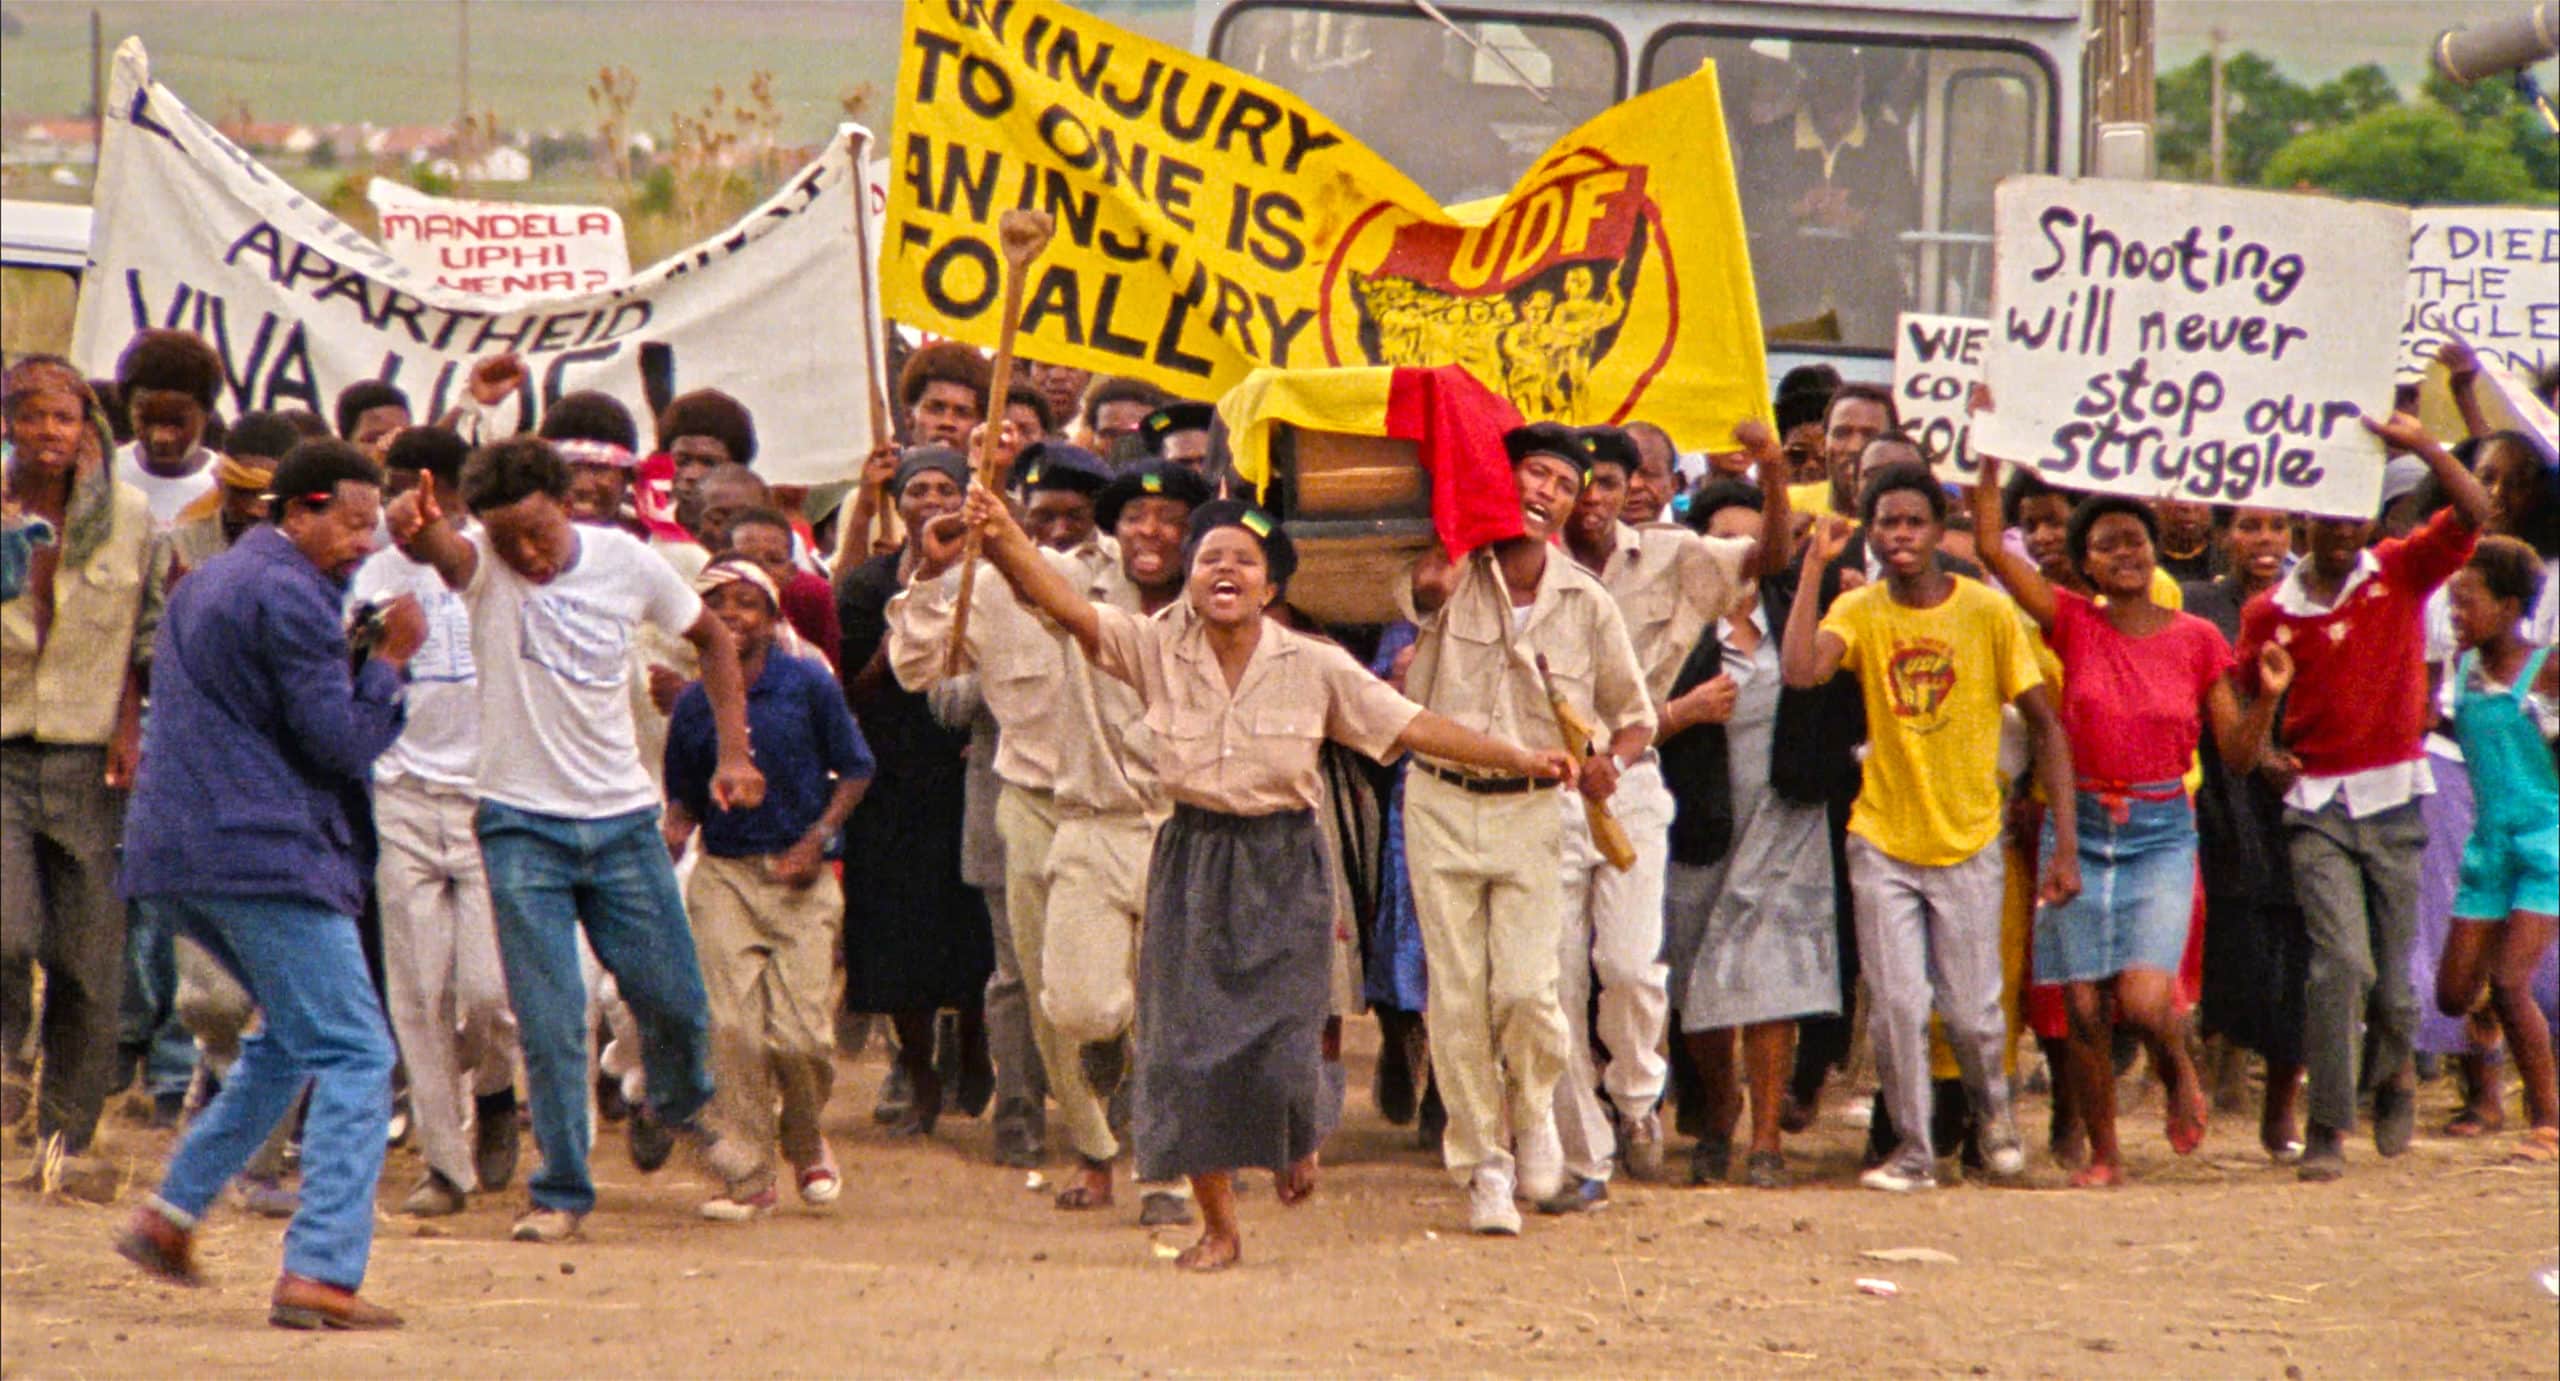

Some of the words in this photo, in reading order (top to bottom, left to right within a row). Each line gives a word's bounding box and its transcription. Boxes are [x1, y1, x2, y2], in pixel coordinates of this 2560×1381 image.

[1022, 15, 1342, 174] INJURY
[905, 132, 1002, 224] AN
[914, 28, 1014, 119] TO
[1037, 104, 1203, 232] ONE
[1226, 184, 1308, 272] IS
[384, 213, 610, 241] MANDELA
[441, 243, 566, 269] UPHI
[1449, 170, 1629, 290] UDF
[2031, 205, 2305, 306] Shooting
[223, 221, 653, 353] APARTHEID
[1019, 264, 1214, 378] ALL
[2006, 284, 2114, 356] will
[2139, 311, 2307, 360] never
[2409, 266, 2510, 300] THE
[1908, 322, 1989, 365] WE
[2075, 357, 2225, 438] stop
[2244, 394, 2361, 439] our
[2037, 412, 2324, 500] struggle
